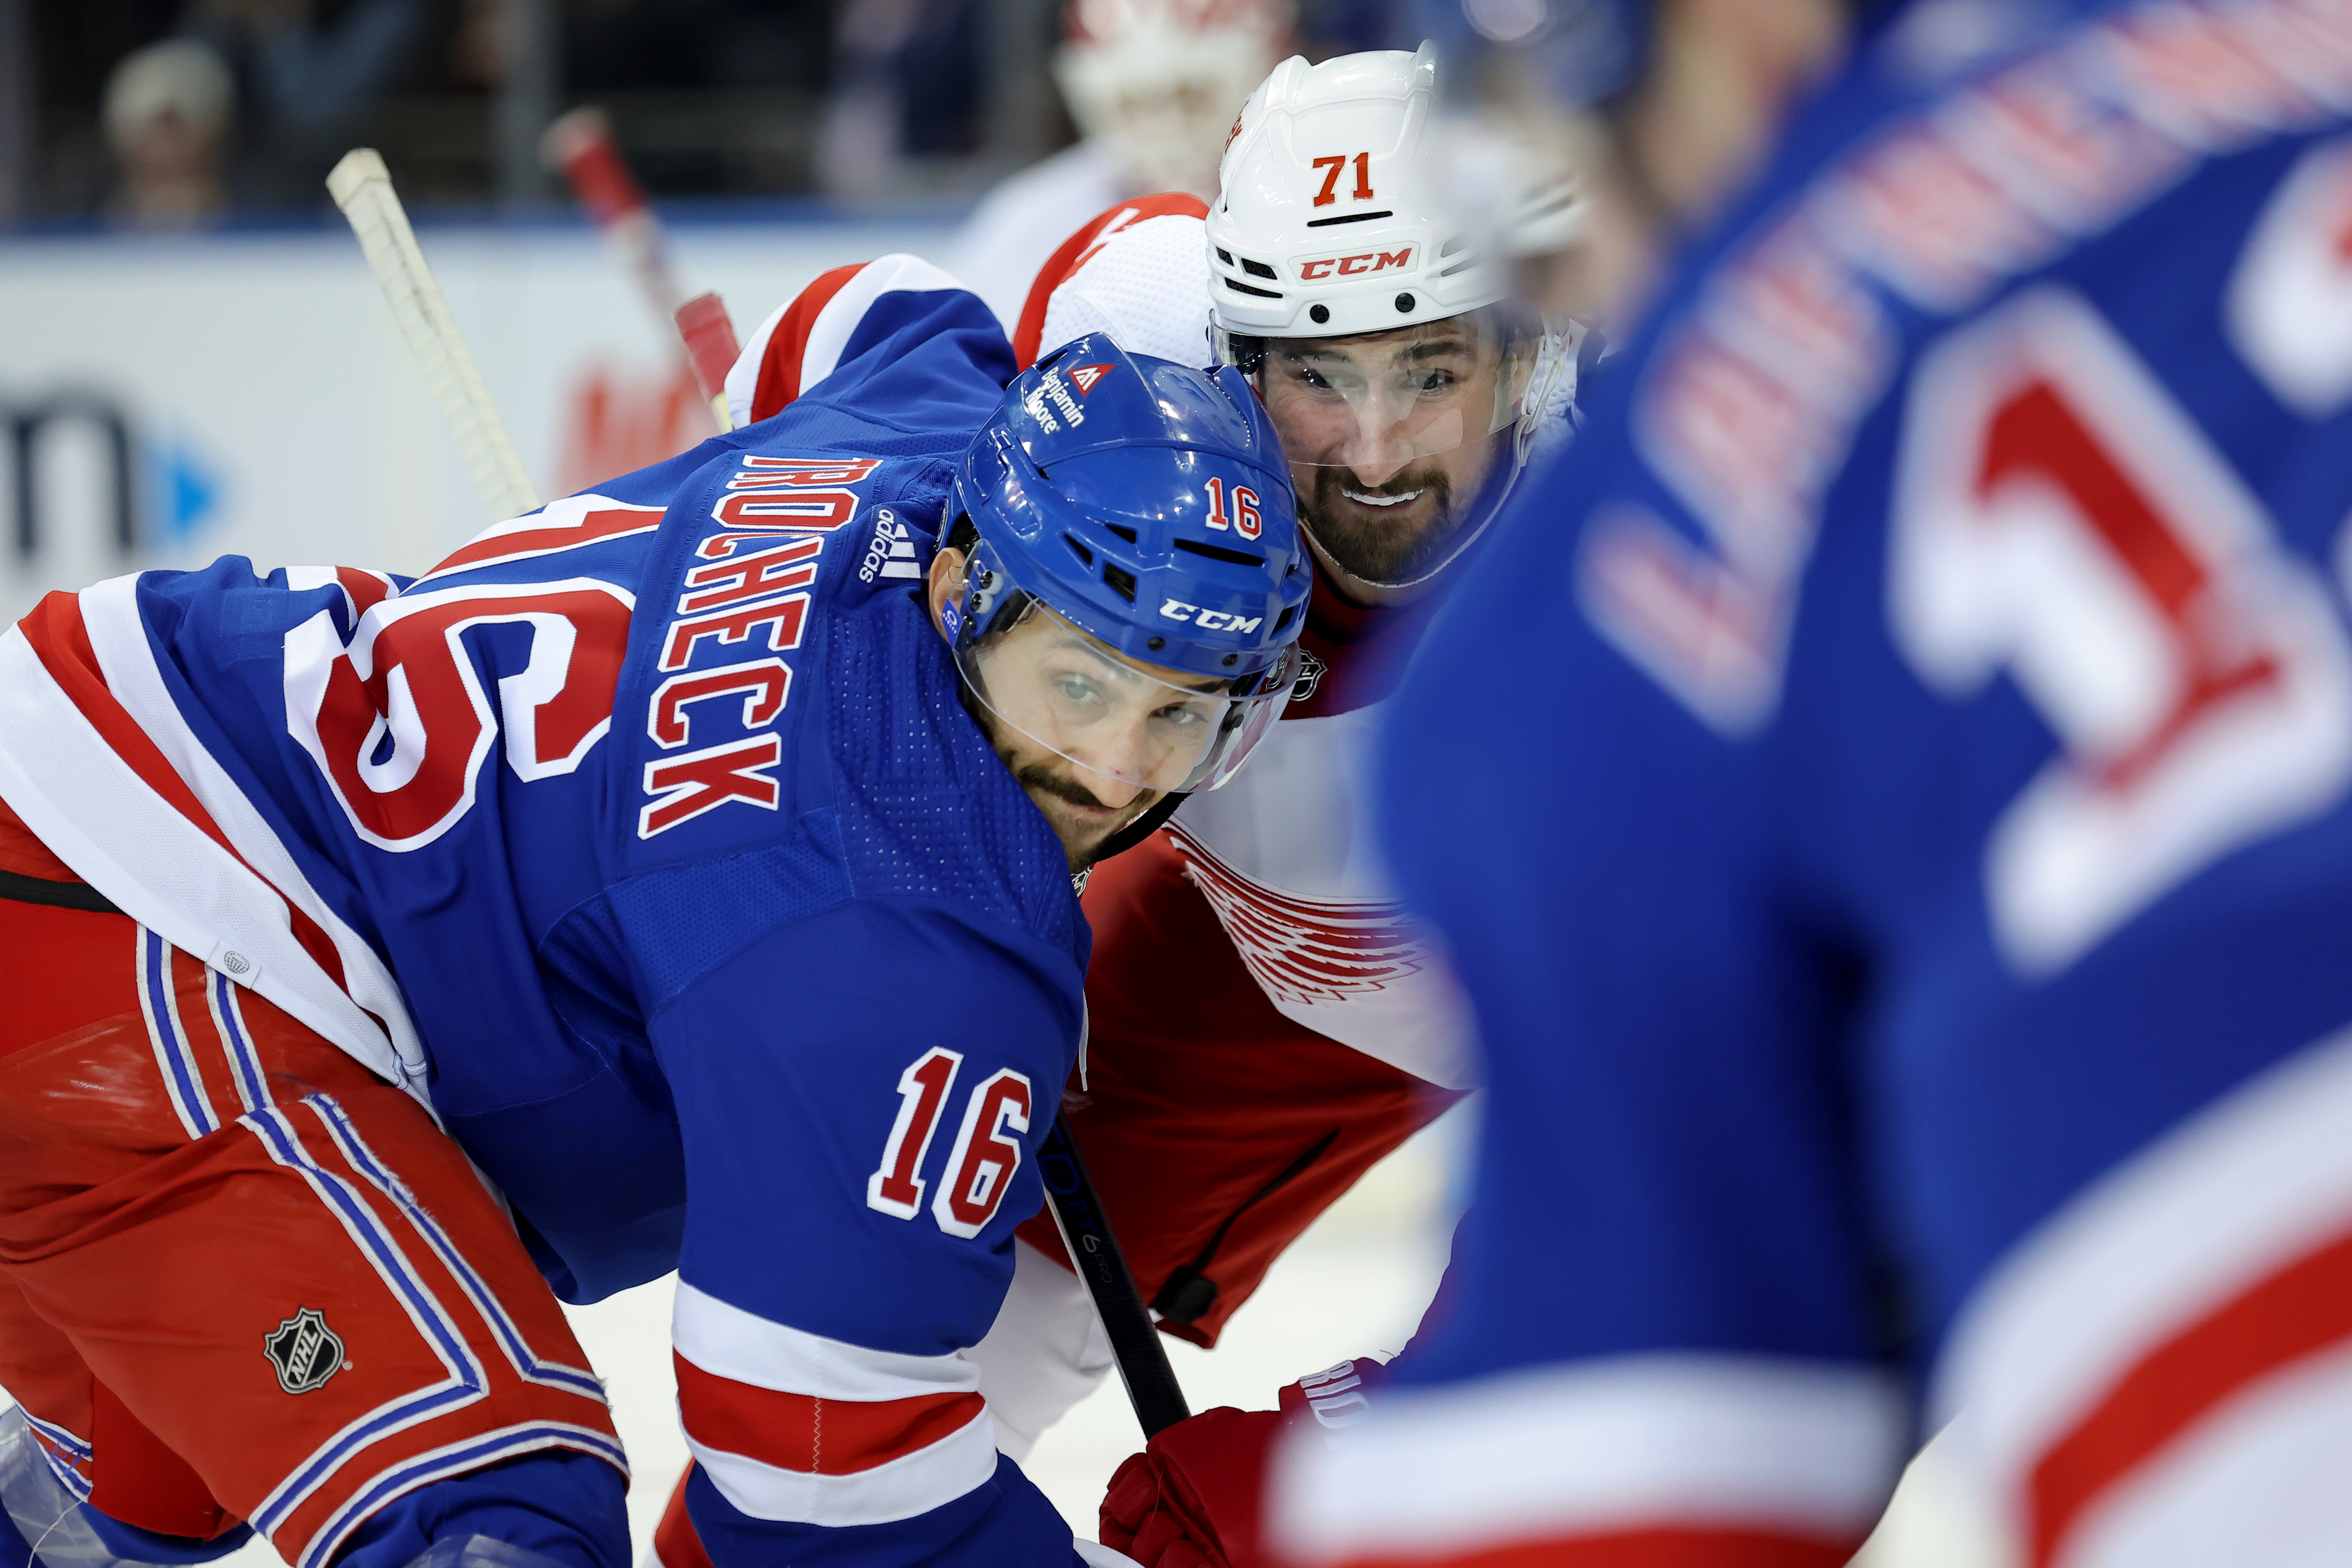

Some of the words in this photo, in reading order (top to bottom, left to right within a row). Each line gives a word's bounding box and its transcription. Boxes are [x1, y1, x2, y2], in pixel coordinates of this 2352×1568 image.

[1312, 151, 1375, 209] 71
[1300, 247, 1413, 280] CCM
[1041, 366, 1085, 428] Benjamin
[1204, 476, 1262, 541] 16
[859, 509, 895, 584] adidas
[1159, 597, 1263, 634] CCM
[867, 1045, 1031, 1239] 16
[1094, 1253, 1113, 1284] PRO
[291, 1330, 319, 1385] NHL
